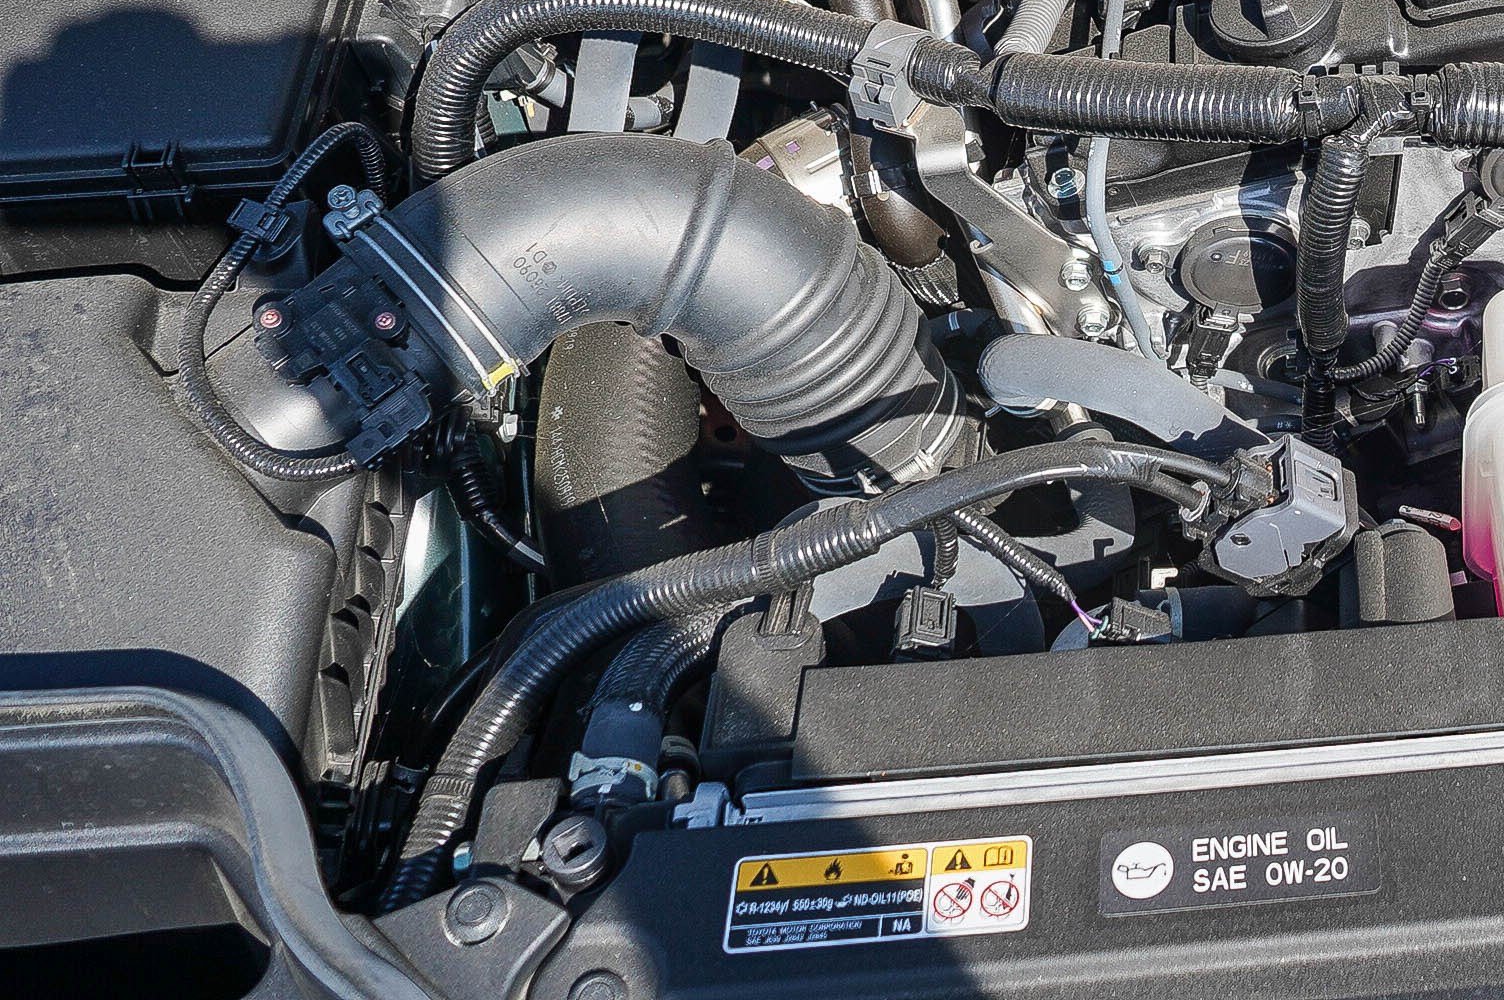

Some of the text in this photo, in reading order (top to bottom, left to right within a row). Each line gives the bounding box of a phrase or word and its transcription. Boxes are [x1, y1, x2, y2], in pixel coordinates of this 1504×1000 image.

[1192, 826, 1349, 862] ENGINE OIL
[1192, 856, 1349, 893] SAE 0W-20
[747, 924, 777, 937] TOYOTA
[779, 922, 807, 935] MOTOR
[892, 917, 912, 933] NA
